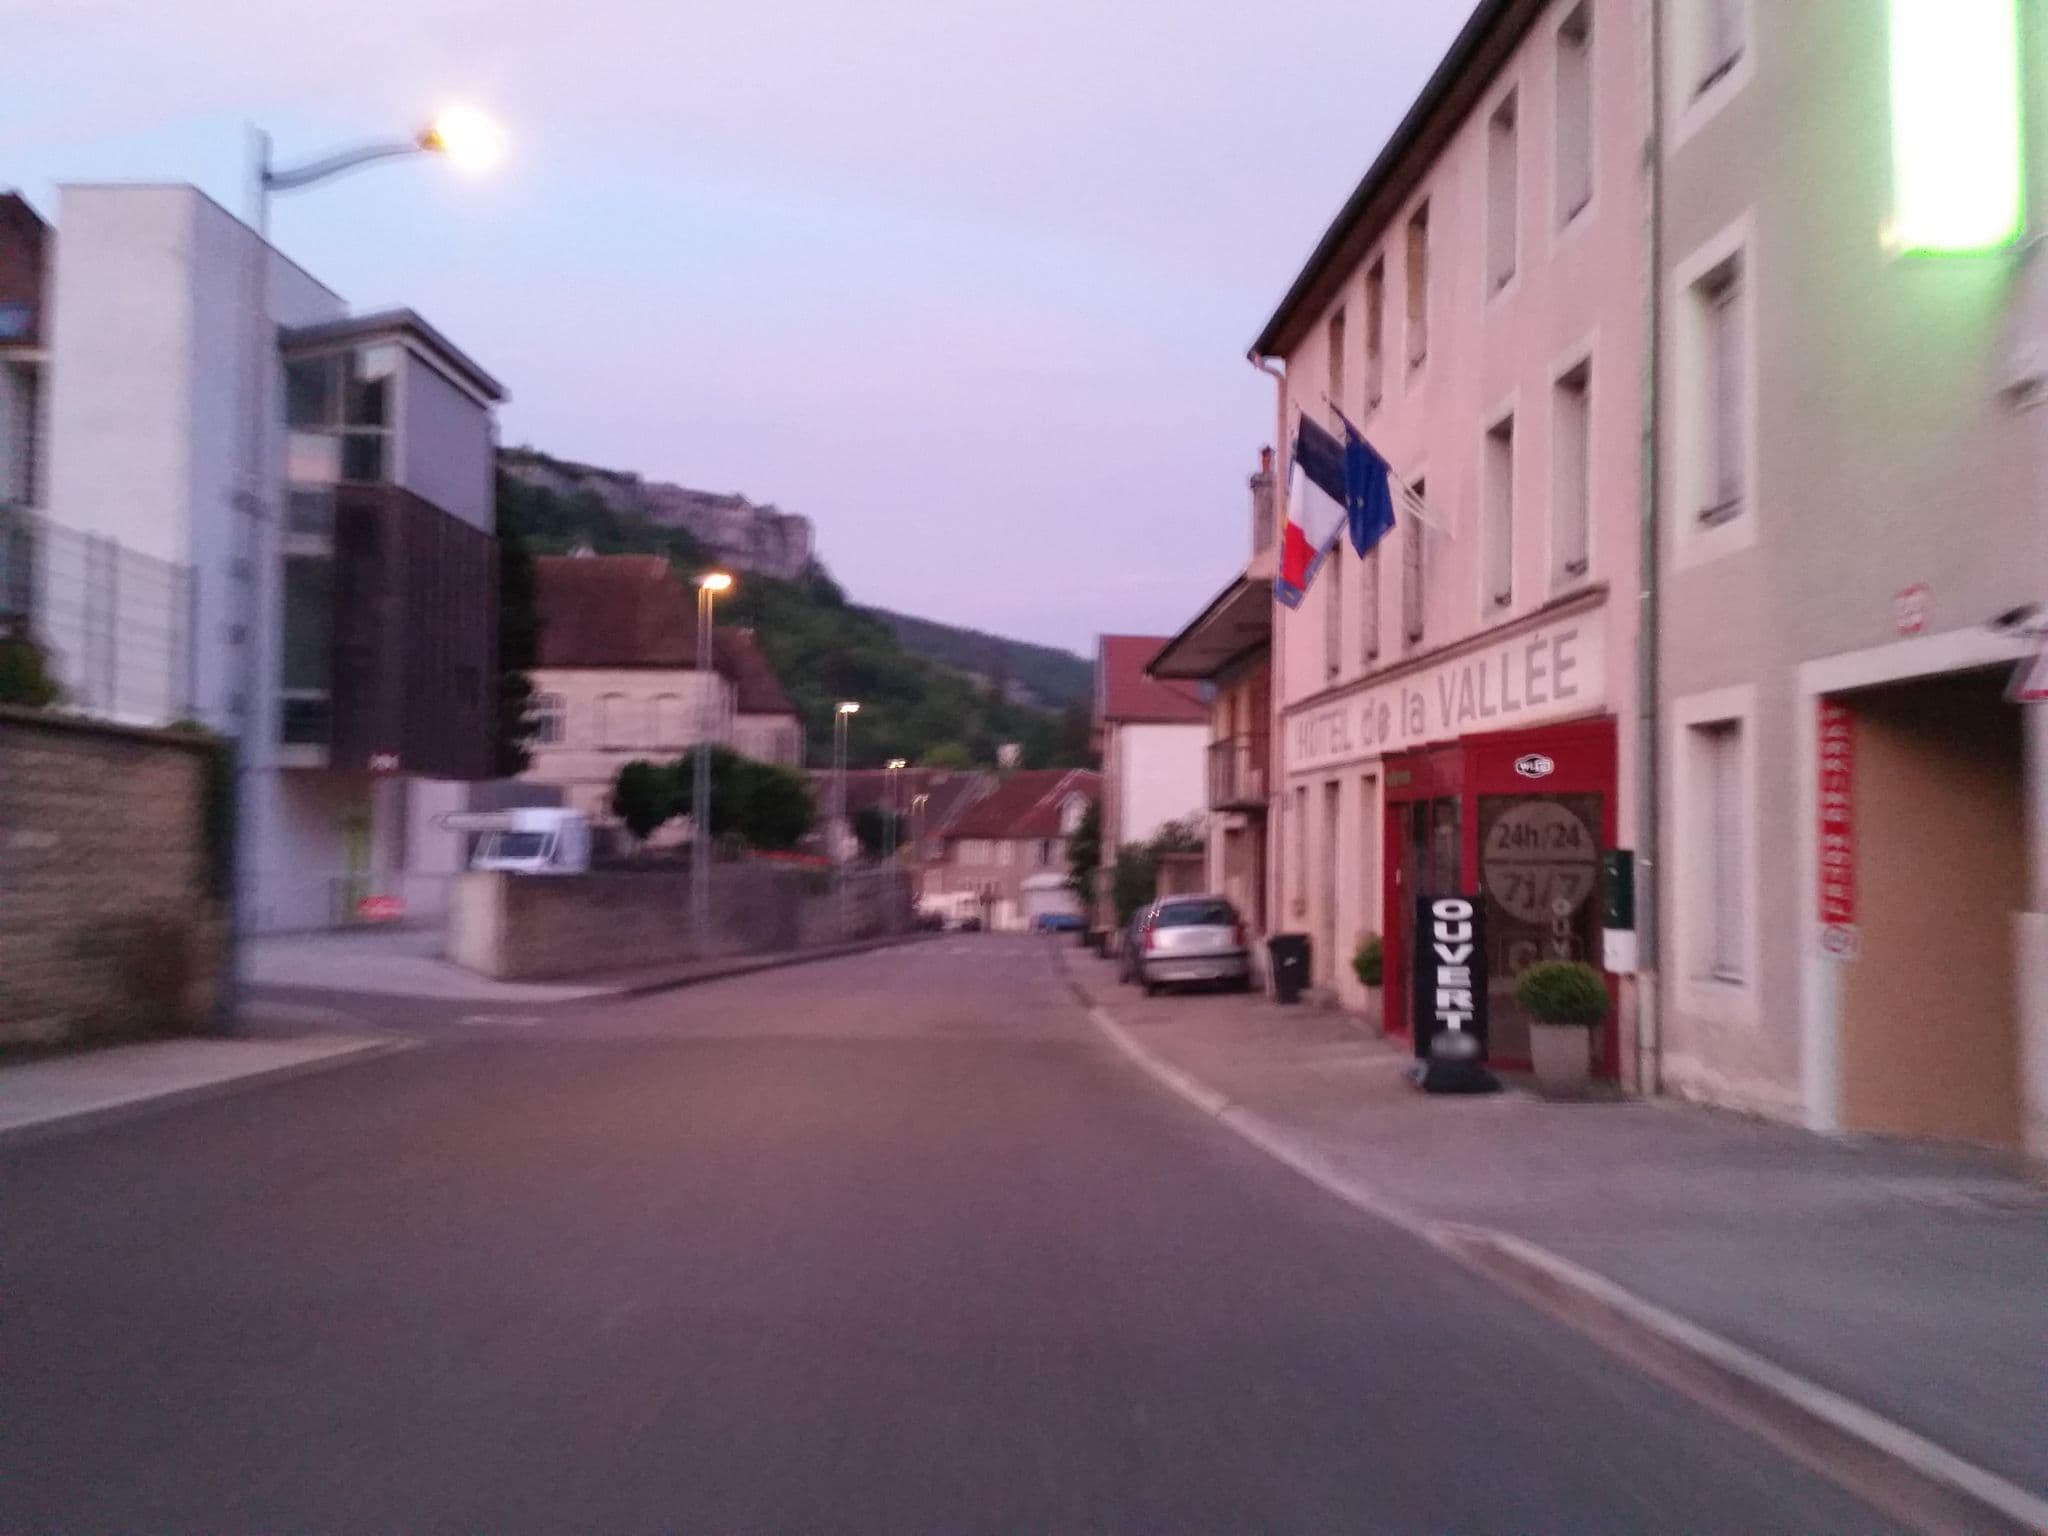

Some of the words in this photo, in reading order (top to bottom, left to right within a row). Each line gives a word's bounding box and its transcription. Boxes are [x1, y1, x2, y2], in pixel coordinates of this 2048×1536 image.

[1401, 688, 1425, 737] la
[1438, 628, 1578, 728] VALLÉE
[1432, 899, 1475, 1030] OUVERT
